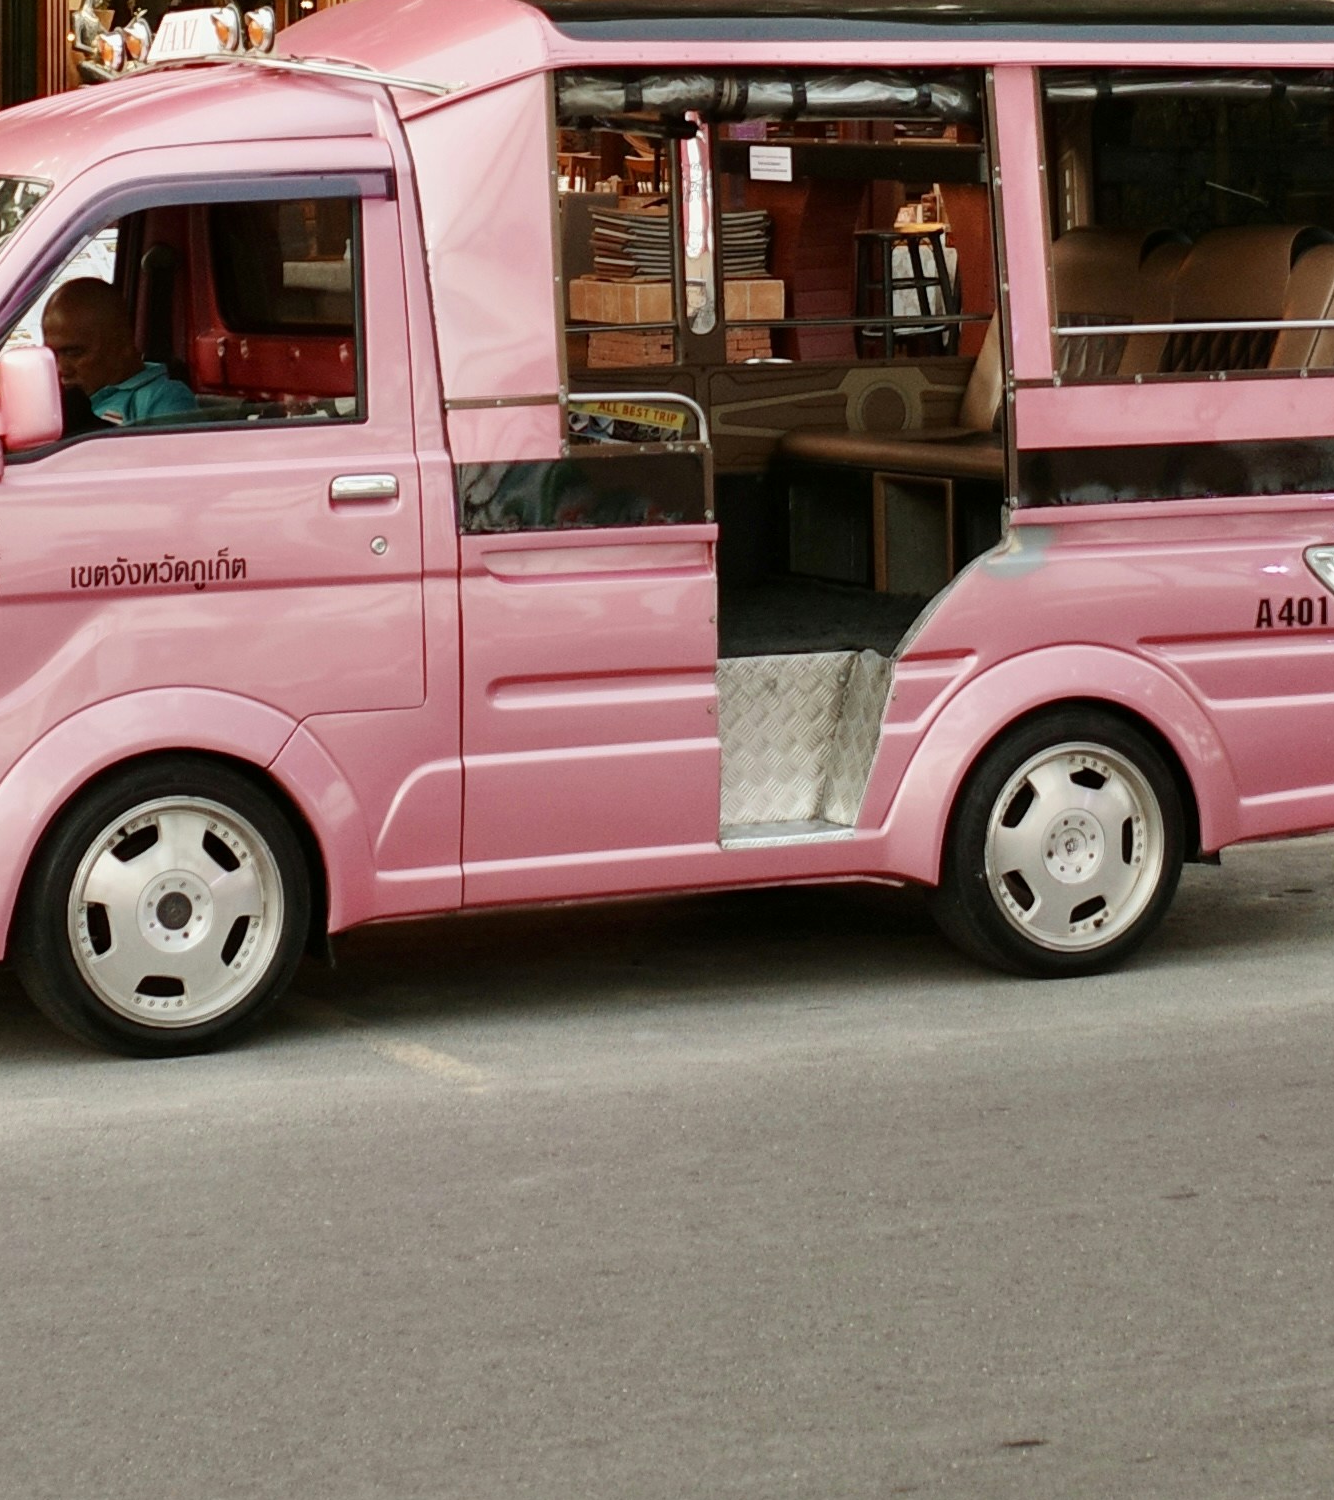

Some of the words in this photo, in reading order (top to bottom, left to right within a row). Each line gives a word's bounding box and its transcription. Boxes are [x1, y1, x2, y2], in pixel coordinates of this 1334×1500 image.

[597, 401, 618, 413] ALL
[622, 404, 650, 418] BEST
[653, 410, 678, 423] TRIP
[70, 547, 247, 590] เขตจังหวัดภูเก็ต
